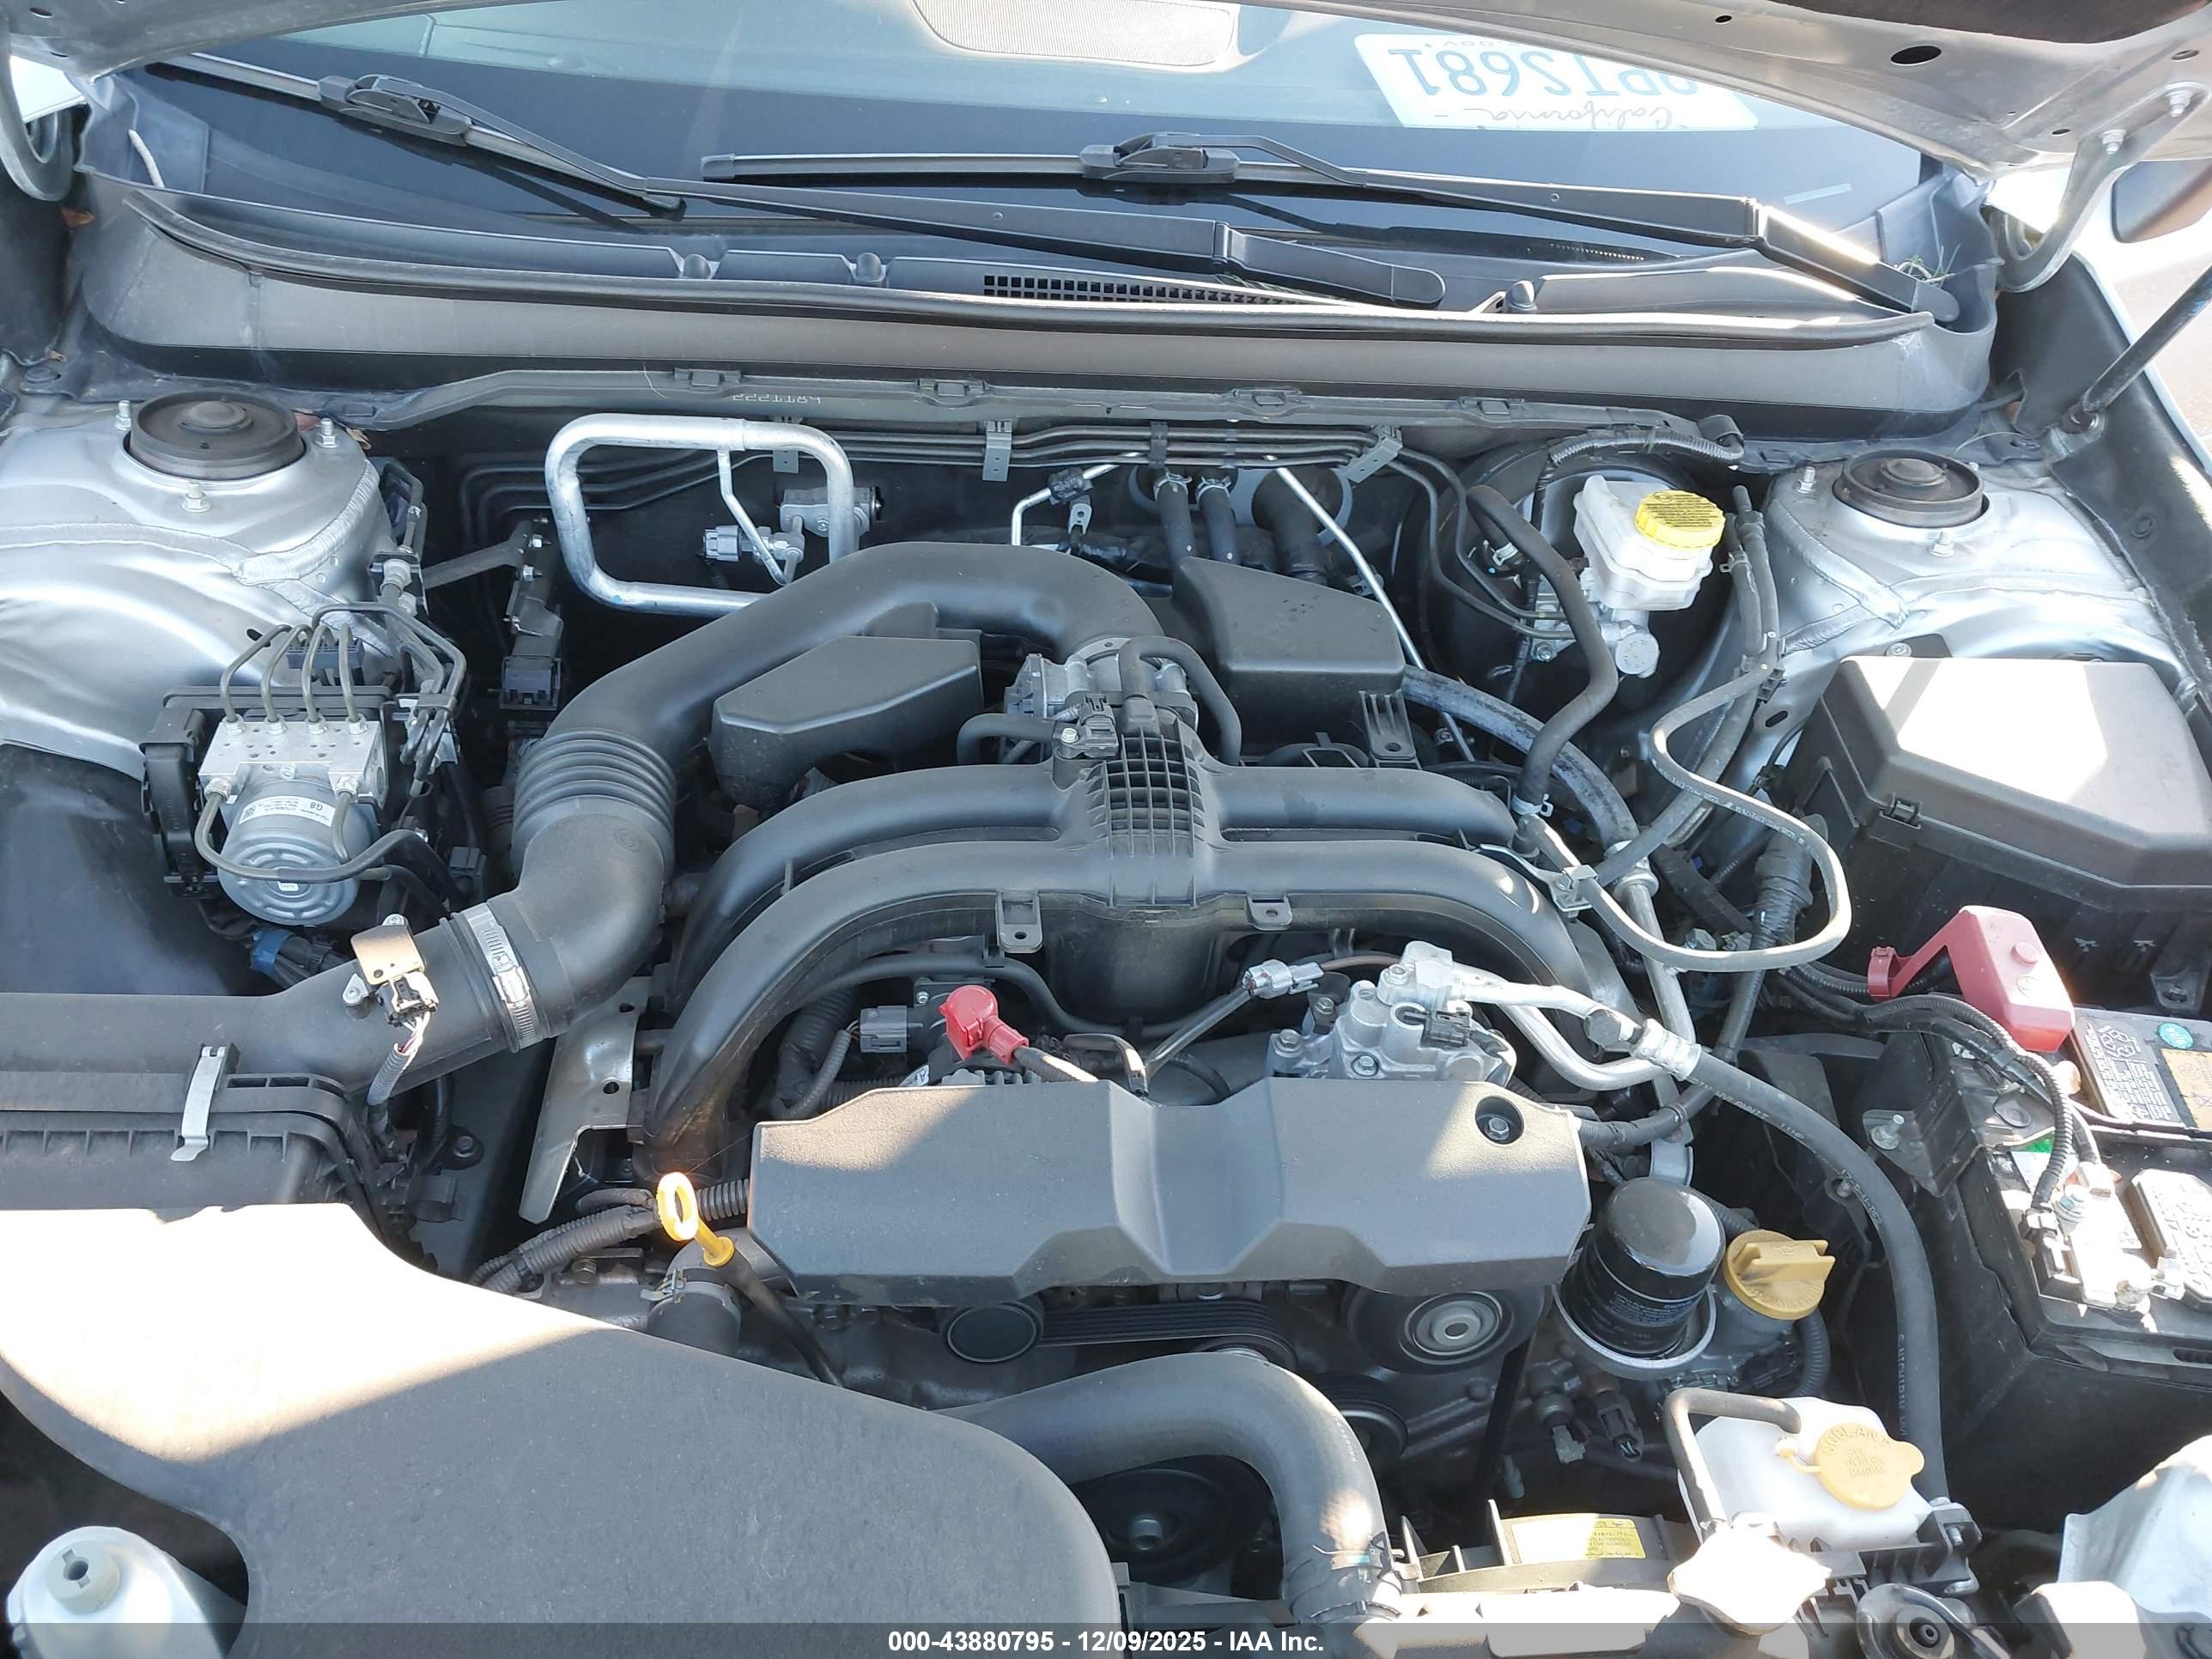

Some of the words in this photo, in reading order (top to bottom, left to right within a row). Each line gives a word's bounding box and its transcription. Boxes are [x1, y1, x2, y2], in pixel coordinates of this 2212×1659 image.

[1462, 100, 1674, 131] California
[309, 800, 324, 812] G8
[1822, 1426, 1891, 1455] COOLANT
